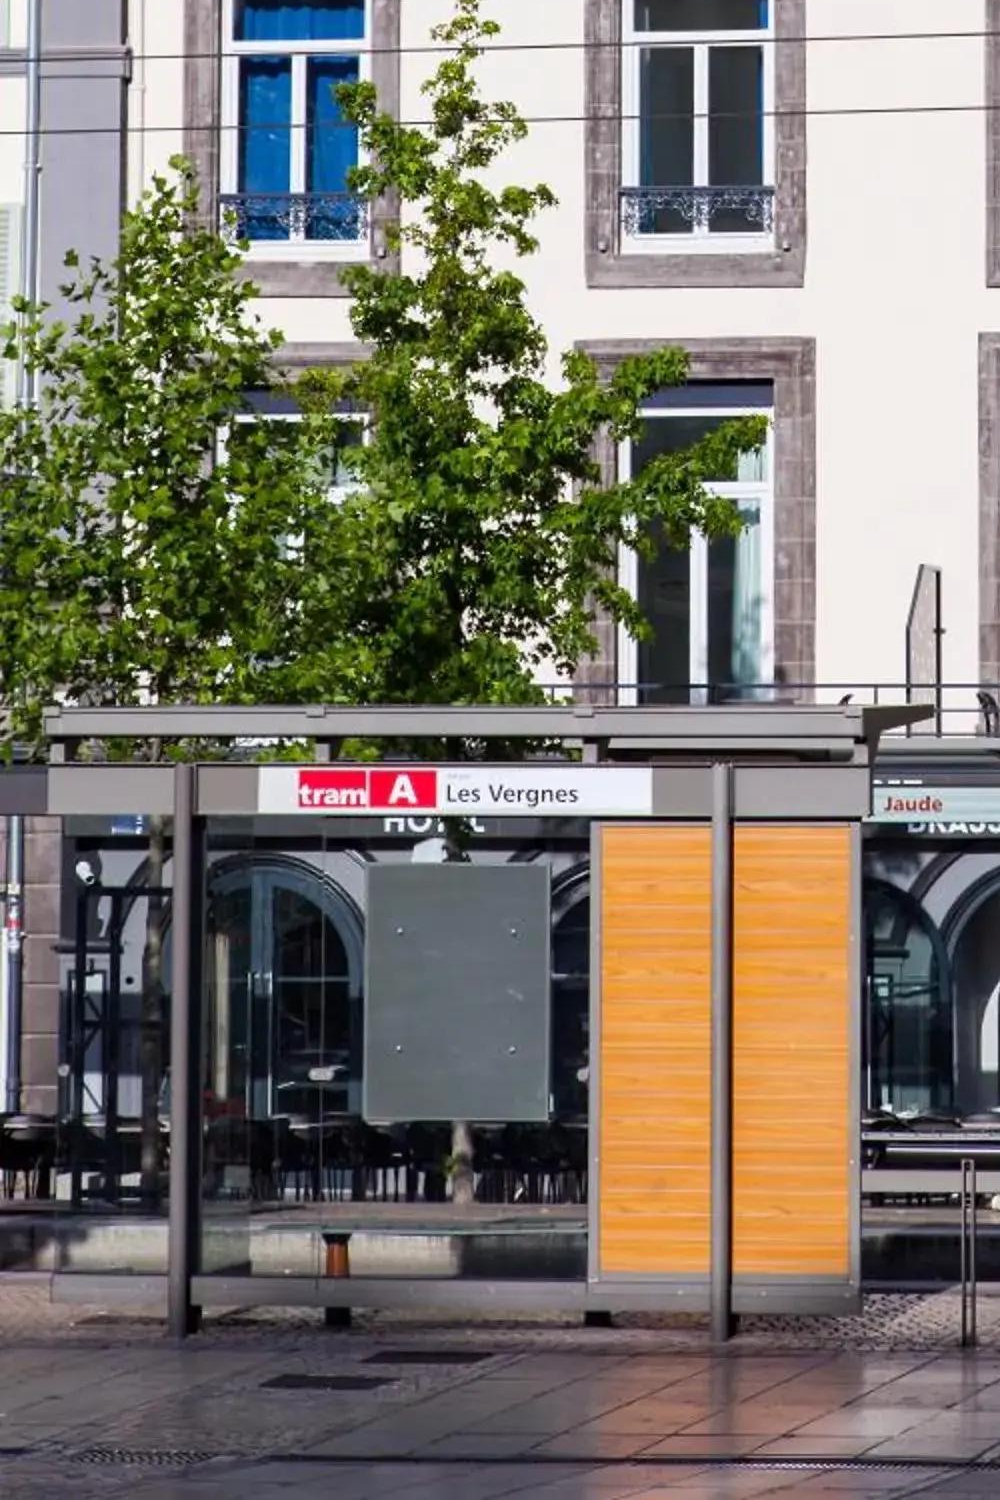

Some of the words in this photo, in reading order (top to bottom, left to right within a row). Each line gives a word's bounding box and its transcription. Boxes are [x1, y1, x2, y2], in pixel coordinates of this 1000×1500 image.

[299, 783, 367, 805] tram
[388, 774, 419, 804] A
[447, 784, 481, 803] Les
[488, 784, 579, 807] Vergnes
[883, 795, 943, 812] Jaude
